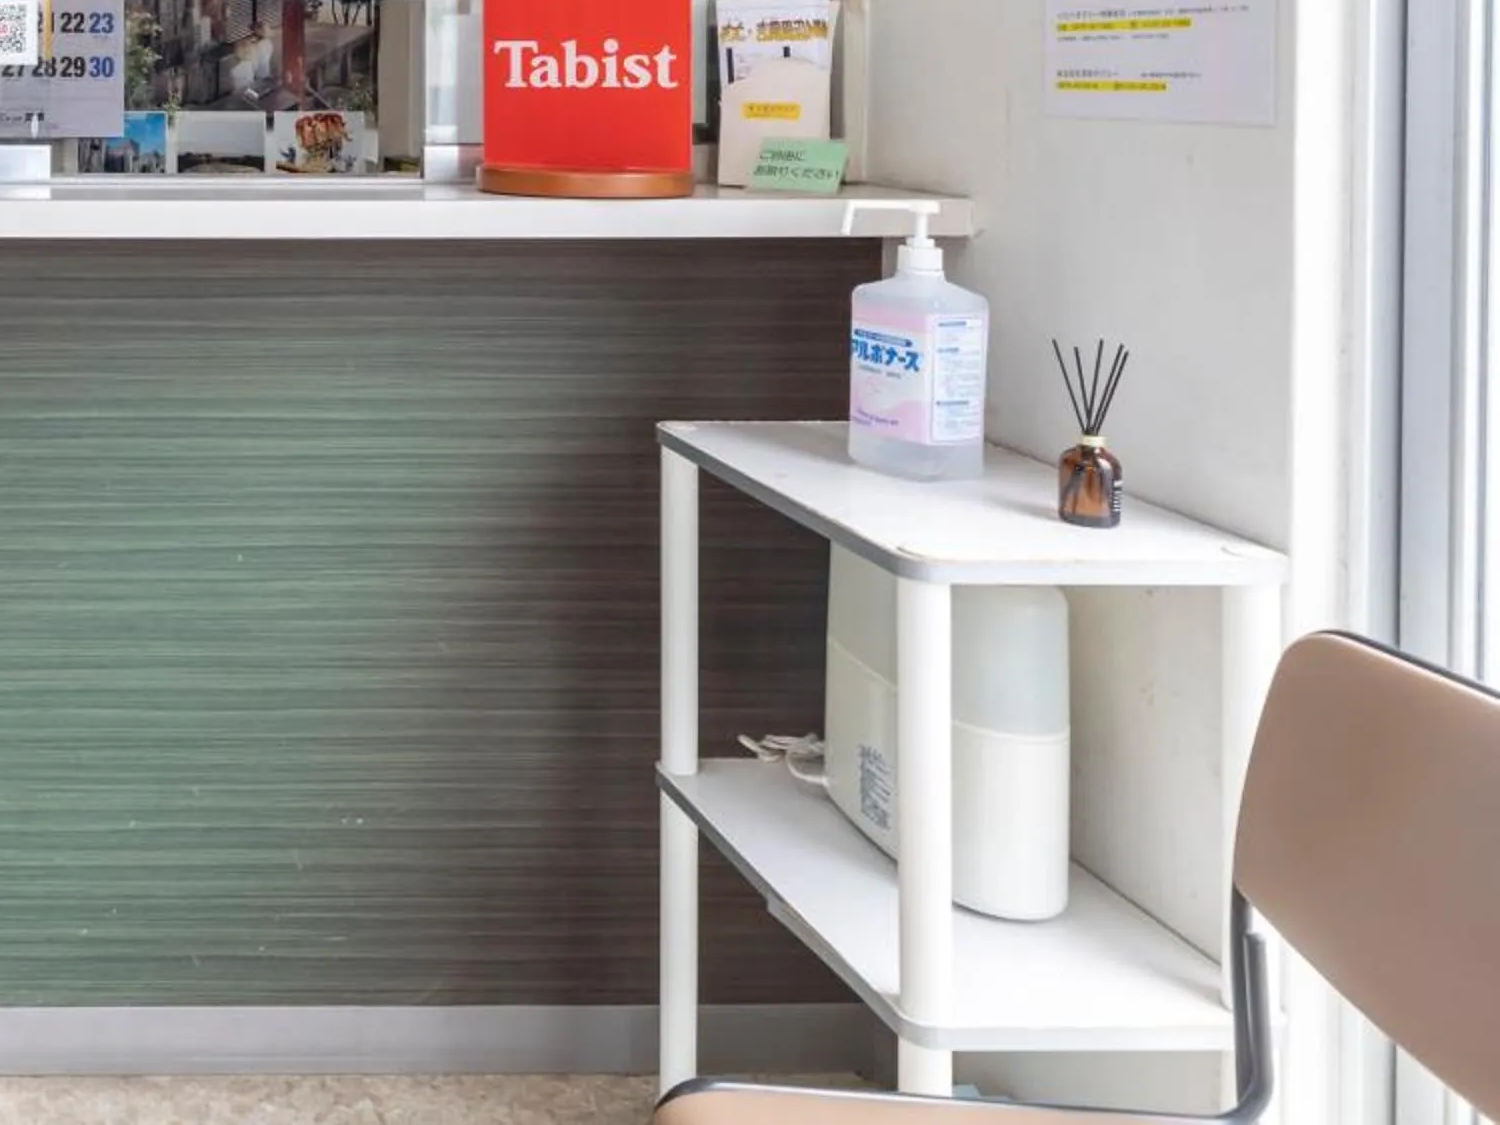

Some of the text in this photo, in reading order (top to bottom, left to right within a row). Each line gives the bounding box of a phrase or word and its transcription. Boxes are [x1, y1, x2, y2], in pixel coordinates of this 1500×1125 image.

[60, 11, 86, 34] 22
[89, 11, 115, 34] 23
[60, 56, 86, 79] 29
[88, 56, 115, 79] 30
[493, 38, 679, 90] Tabist
